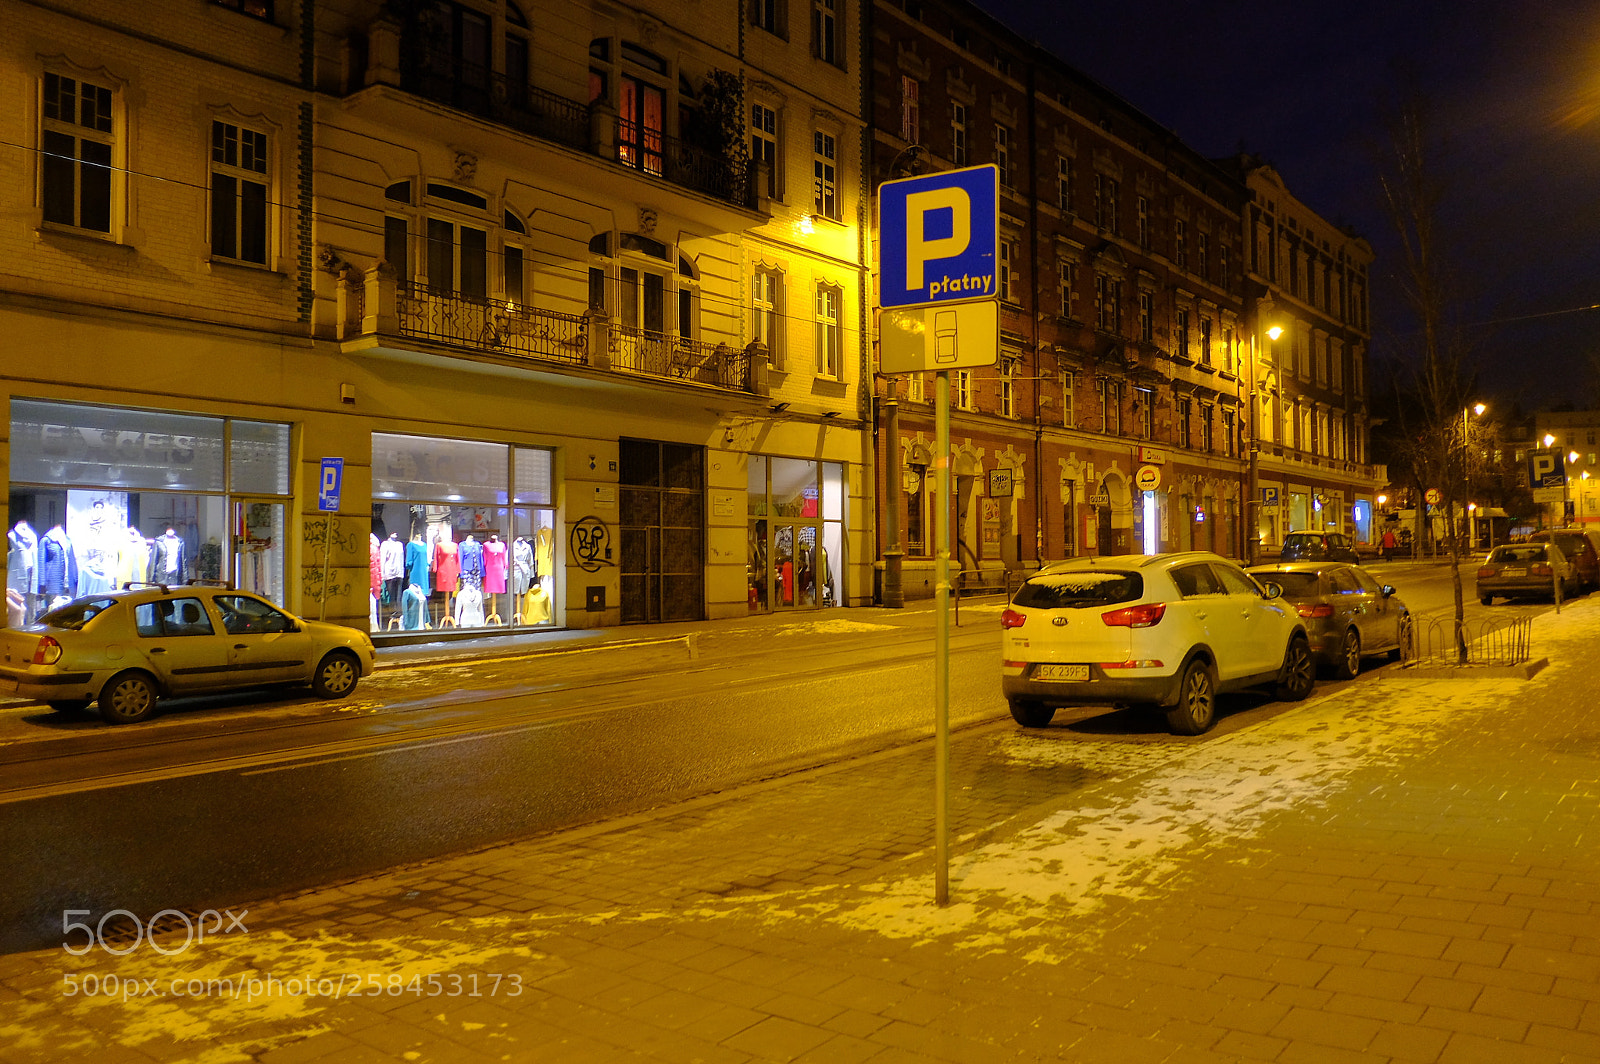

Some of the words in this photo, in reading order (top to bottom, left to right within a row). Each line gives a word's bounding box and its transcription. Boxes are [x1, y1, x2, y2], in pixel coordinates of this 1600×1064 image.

[906, 187, 971, 291] P
[929, 274, 992, 299] płatny
[1533, 455, 1554, 481] P
[322, 467, 336, 499] P
[1265, 489, 1275, 501] P
[1053, 617, 1068, 626] KIA
[1042, 666, 1055, 676] SK
[1058, 666, 1088, 677] 239FS
